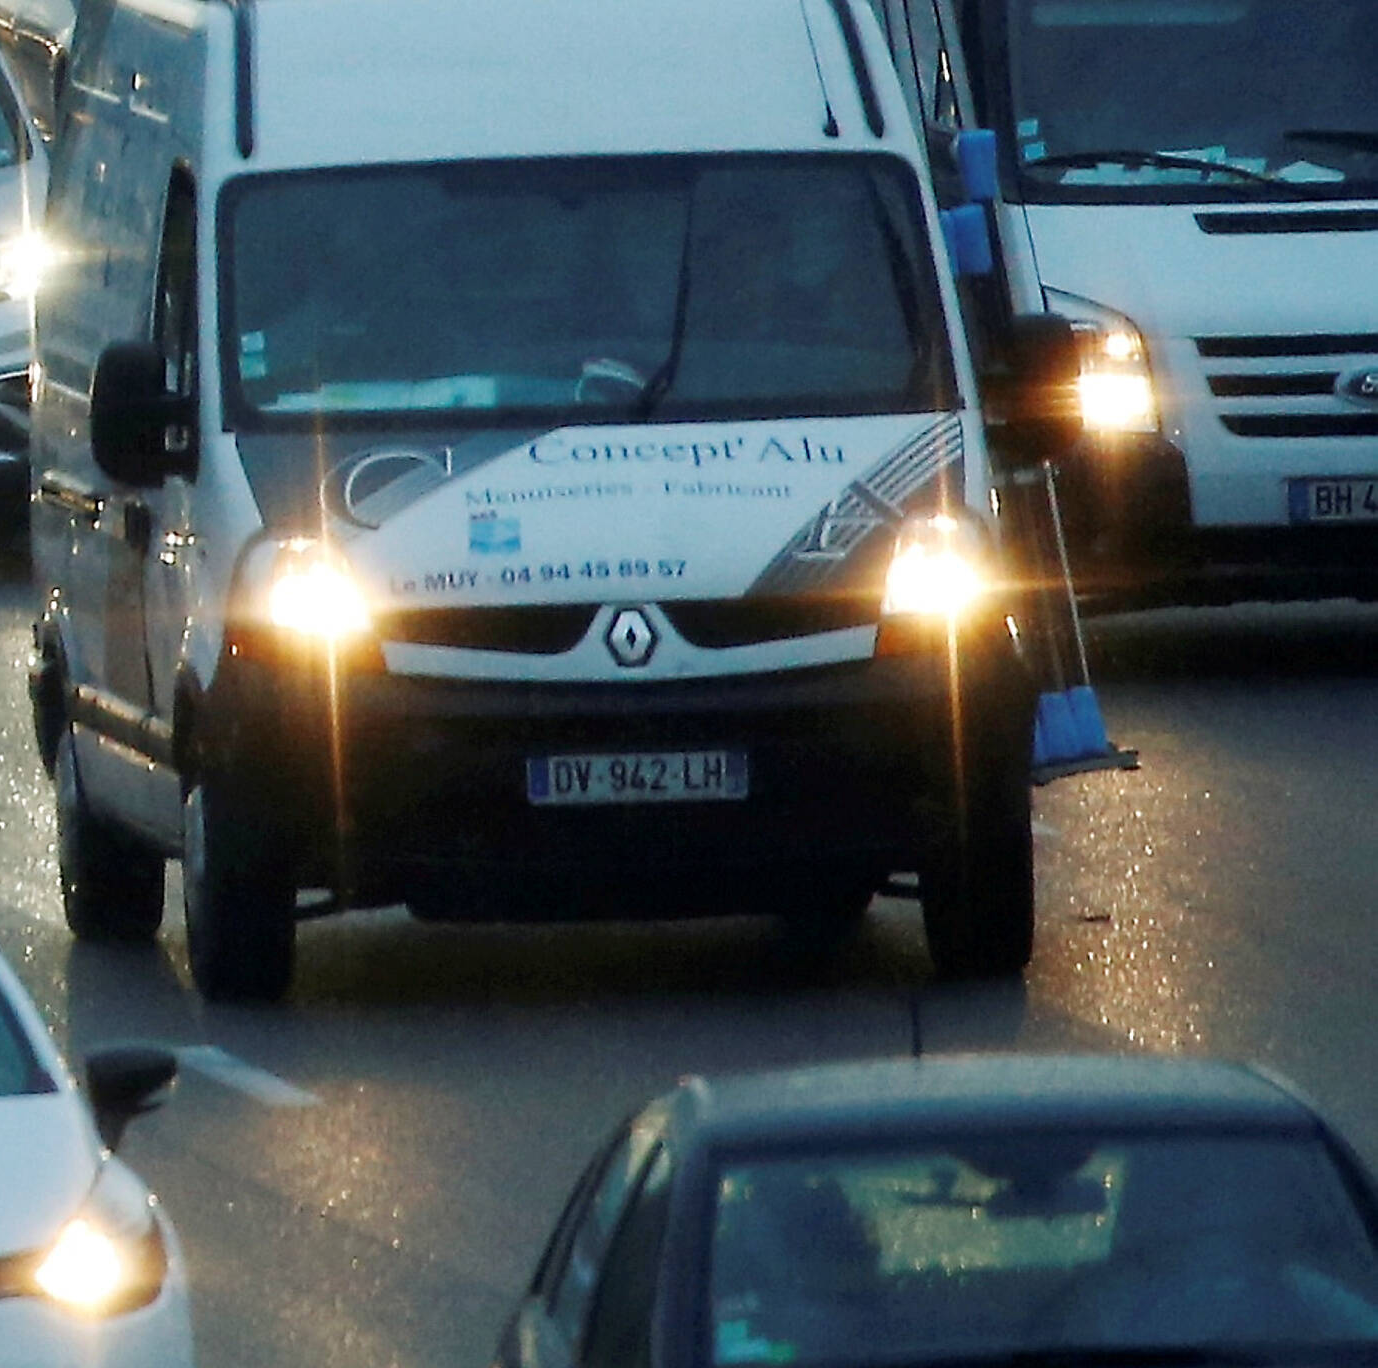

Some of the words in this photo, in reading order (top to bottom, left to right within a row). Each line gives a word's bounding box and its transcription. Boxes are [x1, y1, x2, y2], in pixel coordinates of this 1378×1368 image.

[425, 573, 477, 592] MUY
[500, 567, 532, 586] 04
[544, 562, 571, 581] 94
[657, 558, 688, 577] 57
